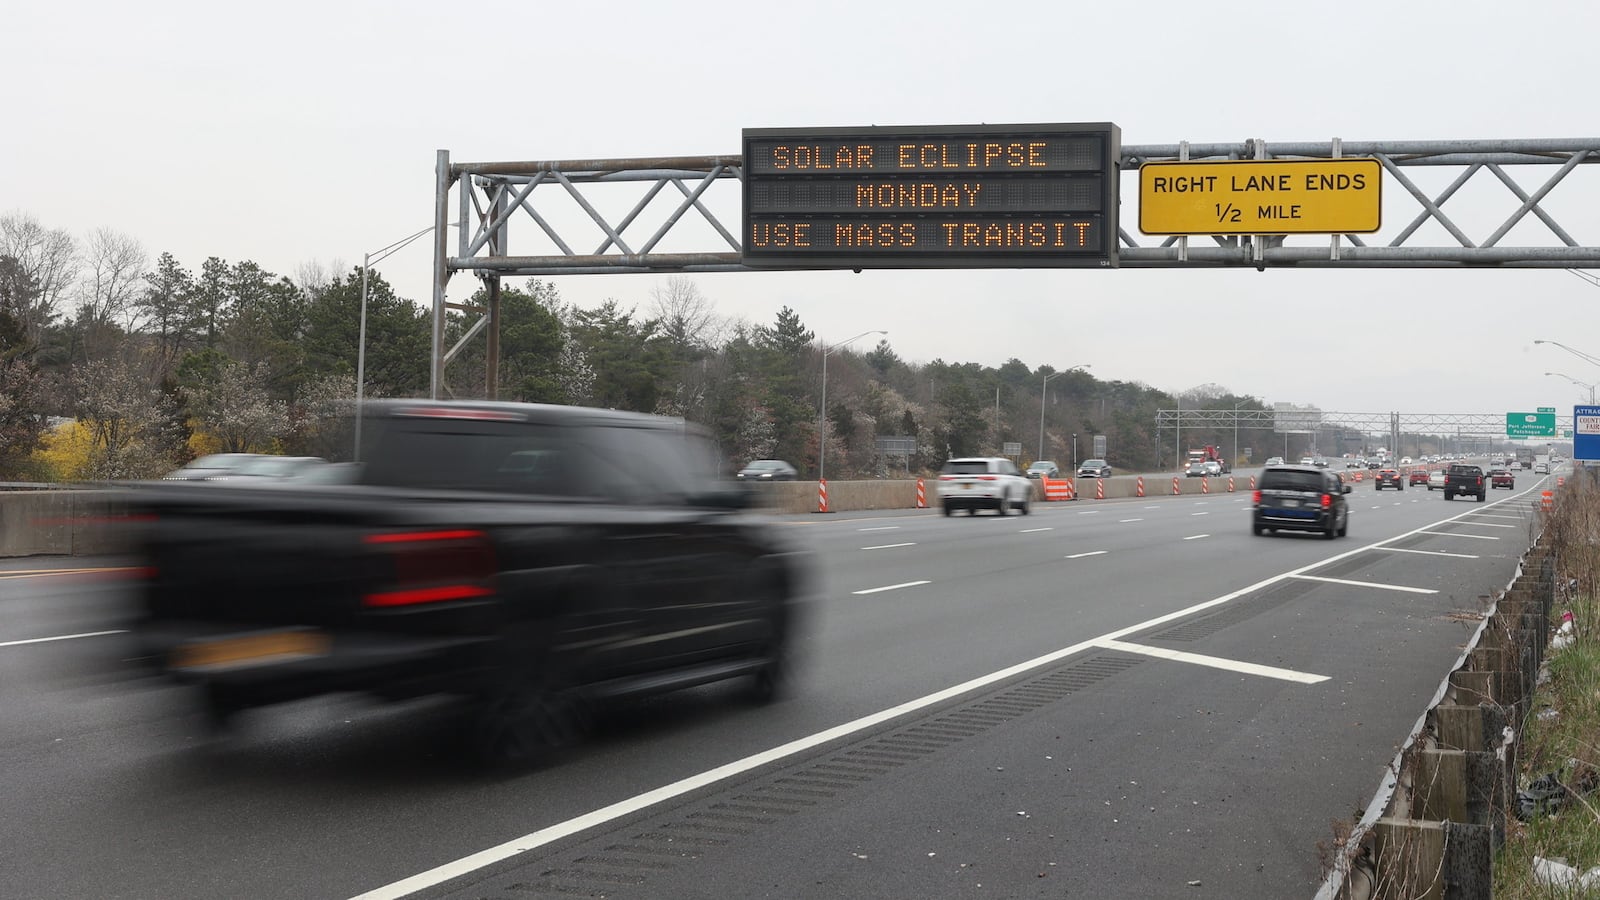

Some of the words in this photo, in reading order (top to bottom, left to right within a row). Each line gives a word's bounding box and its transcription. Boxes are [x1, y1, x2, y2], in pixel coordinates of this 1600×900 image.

[773, 145, 874, 169] SOLAR
[899, 143, 1047, 168] ECLIPSE
[857, 183, 981, 207] MONDAY
[1154, 177, 1217, 193] RIGHT
[1231, 175, 1291, 192] LANE
[1305, 174, 1366, 191] ENDS
[1215, 203, 1242, 222] 1/2
[1258, 205, 1302, 219] MILE
[753, 223, 811, 247] USE
[836, 223, 917, 247] MASS
[942, 222, 1091, 247] TRANSIT
